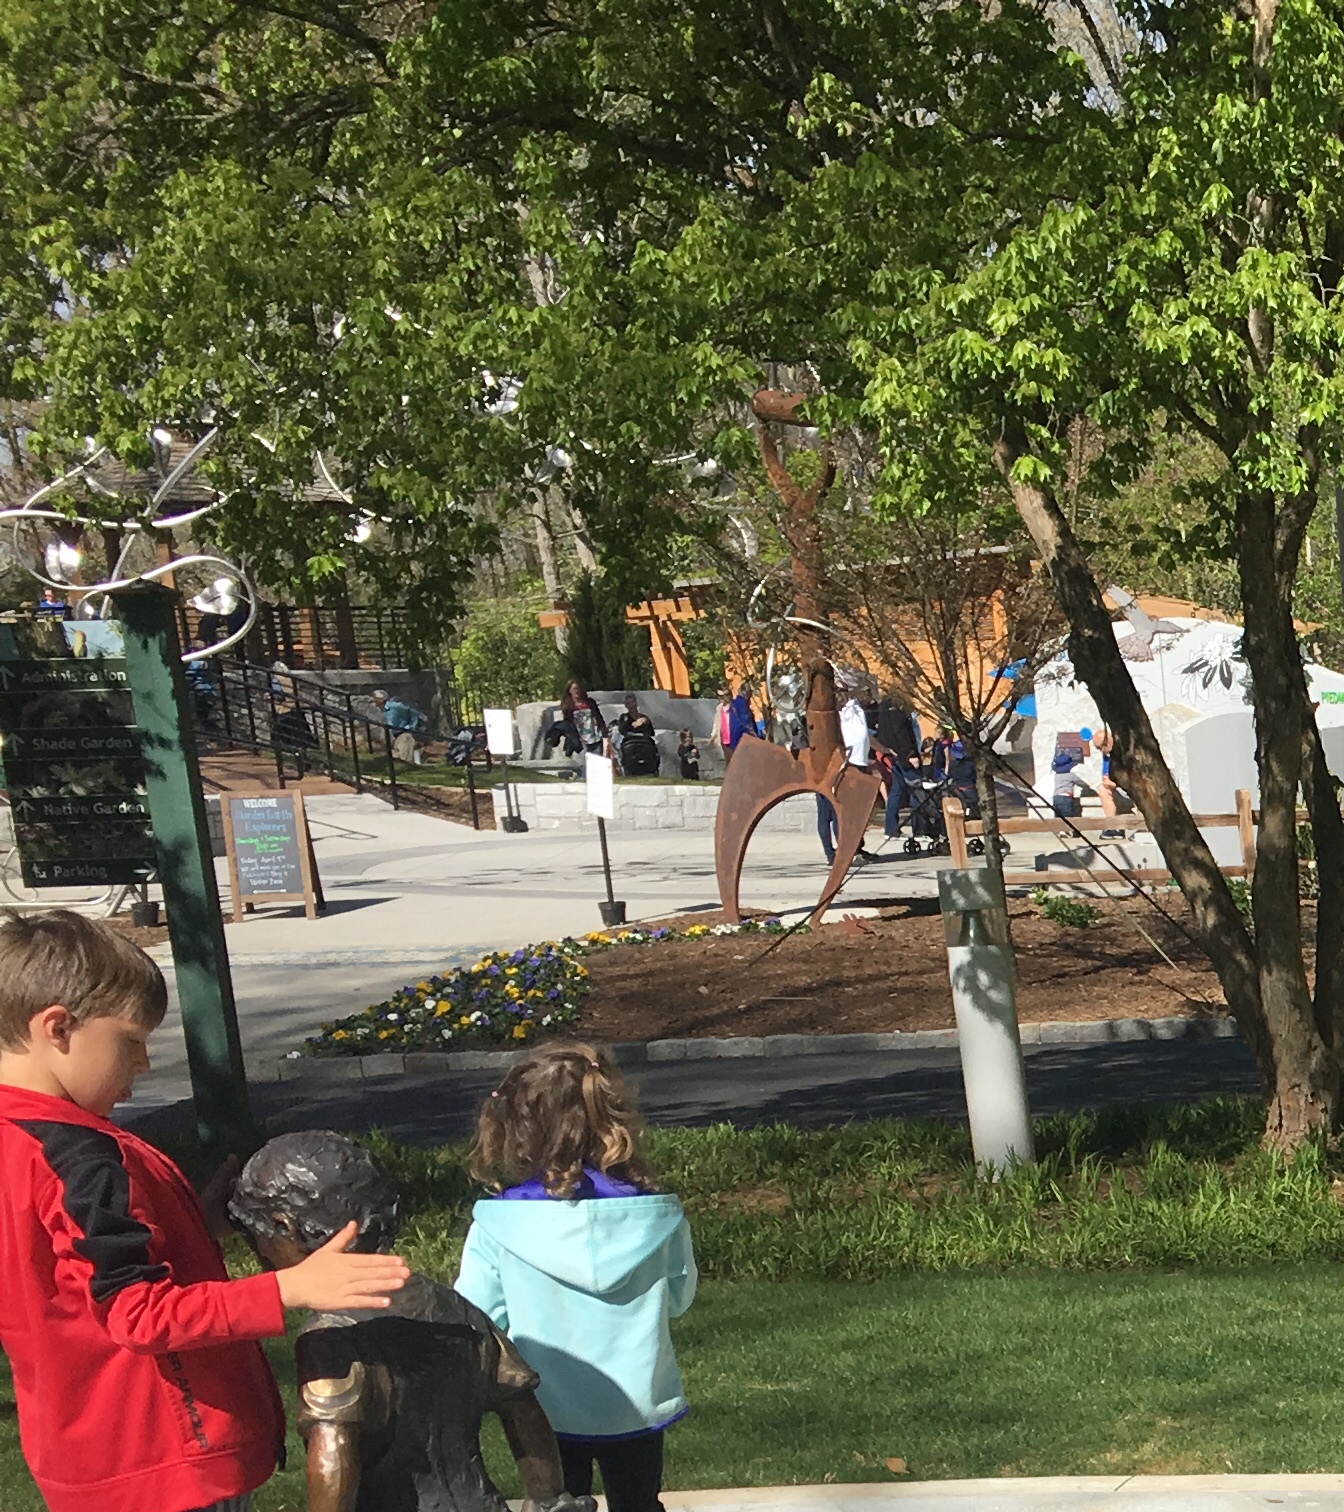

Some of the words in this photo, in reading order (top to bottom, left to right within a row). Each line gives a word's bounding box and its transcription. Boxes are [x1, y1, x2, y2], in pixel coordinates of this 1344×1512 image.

[22, 669, 126, 682] Administration
[32, 738, 76, 750] Shade
[81, 737, 133, 750] Garden
[43, 803, 89, 816] Native
[93, 801, 145, 814] Garden
[243, 798, 277, 808] WELCOME
[53, 865, 107, 878] Parking
[175, 1377, 208, 1448] ARMOUR
